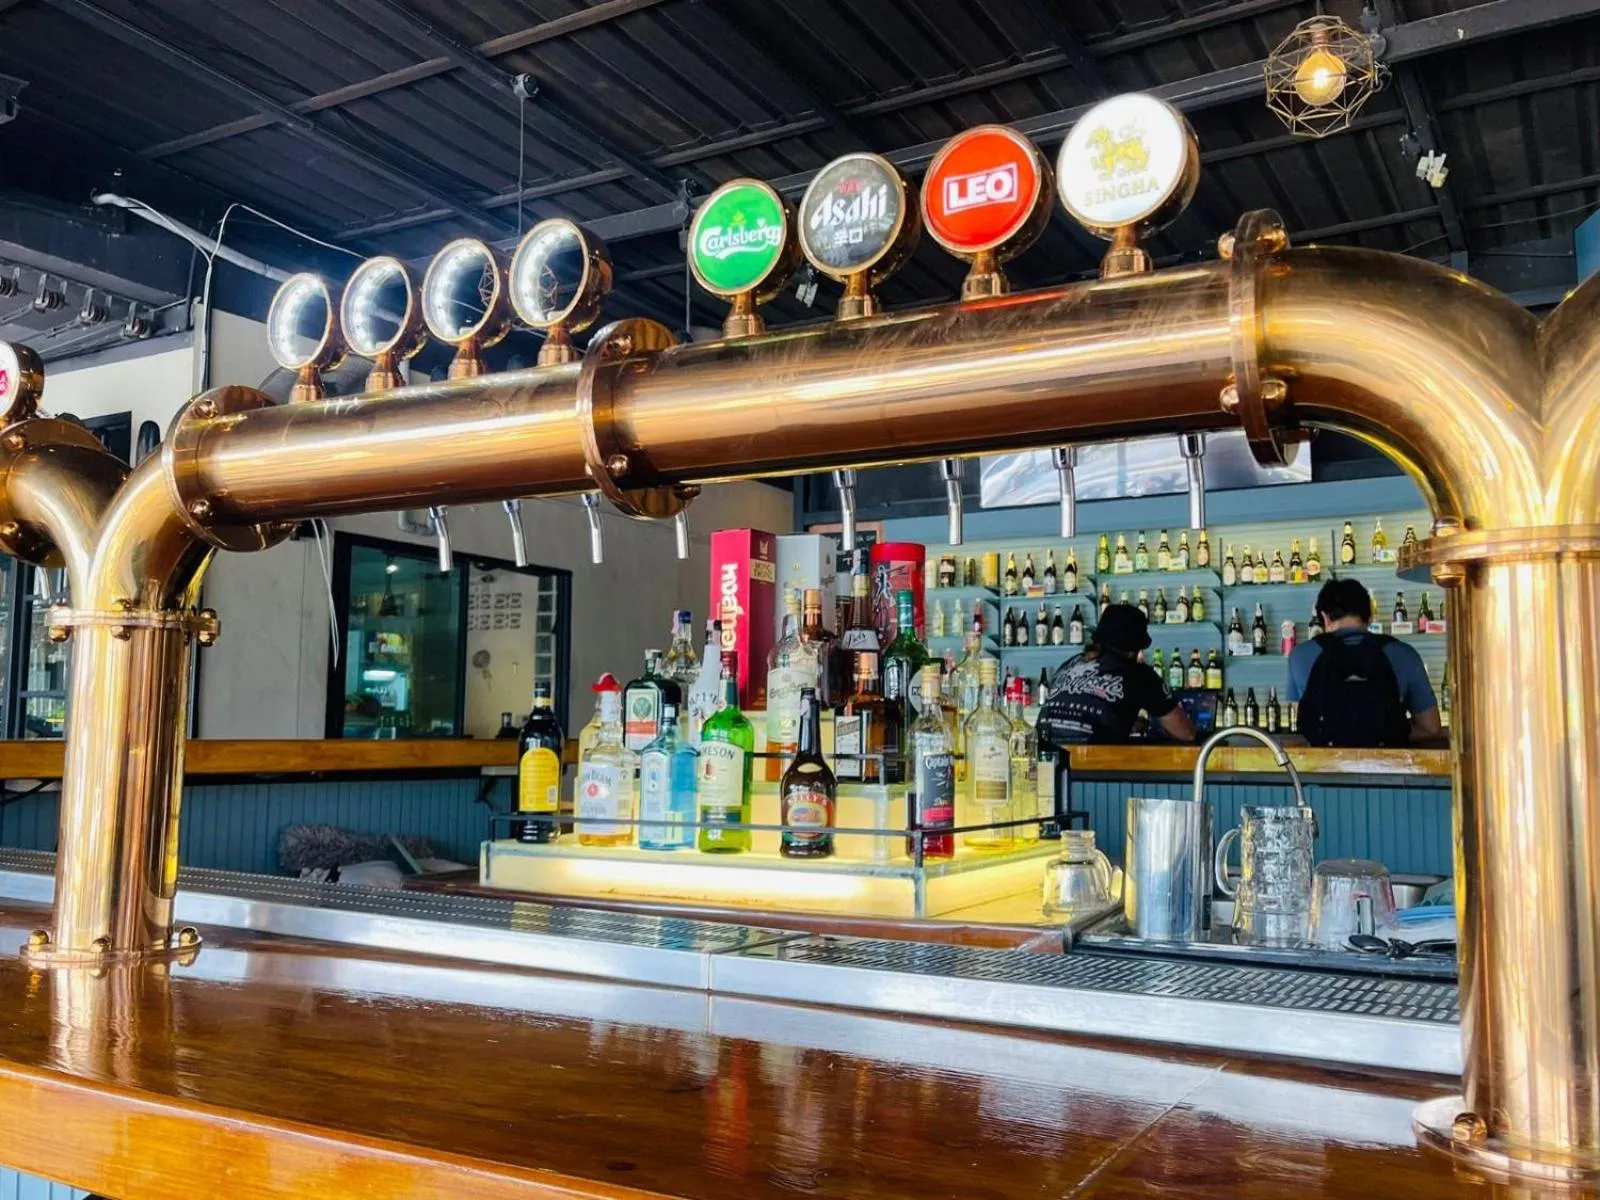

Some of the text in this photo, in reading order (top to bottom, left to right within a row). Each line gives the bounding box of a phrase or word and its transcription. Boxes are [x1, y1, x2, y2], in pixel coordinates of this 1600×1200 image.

[947, 169, 1016, 209] LEO
[1083, 178, 1161, 208] SINGHA
[811, 184, 888, 229] Asahi
[700, 219, 782, 255] Carlsberg
[833, 228, 863, 247] 辛口
[702, 745, 735, 759] MESON
